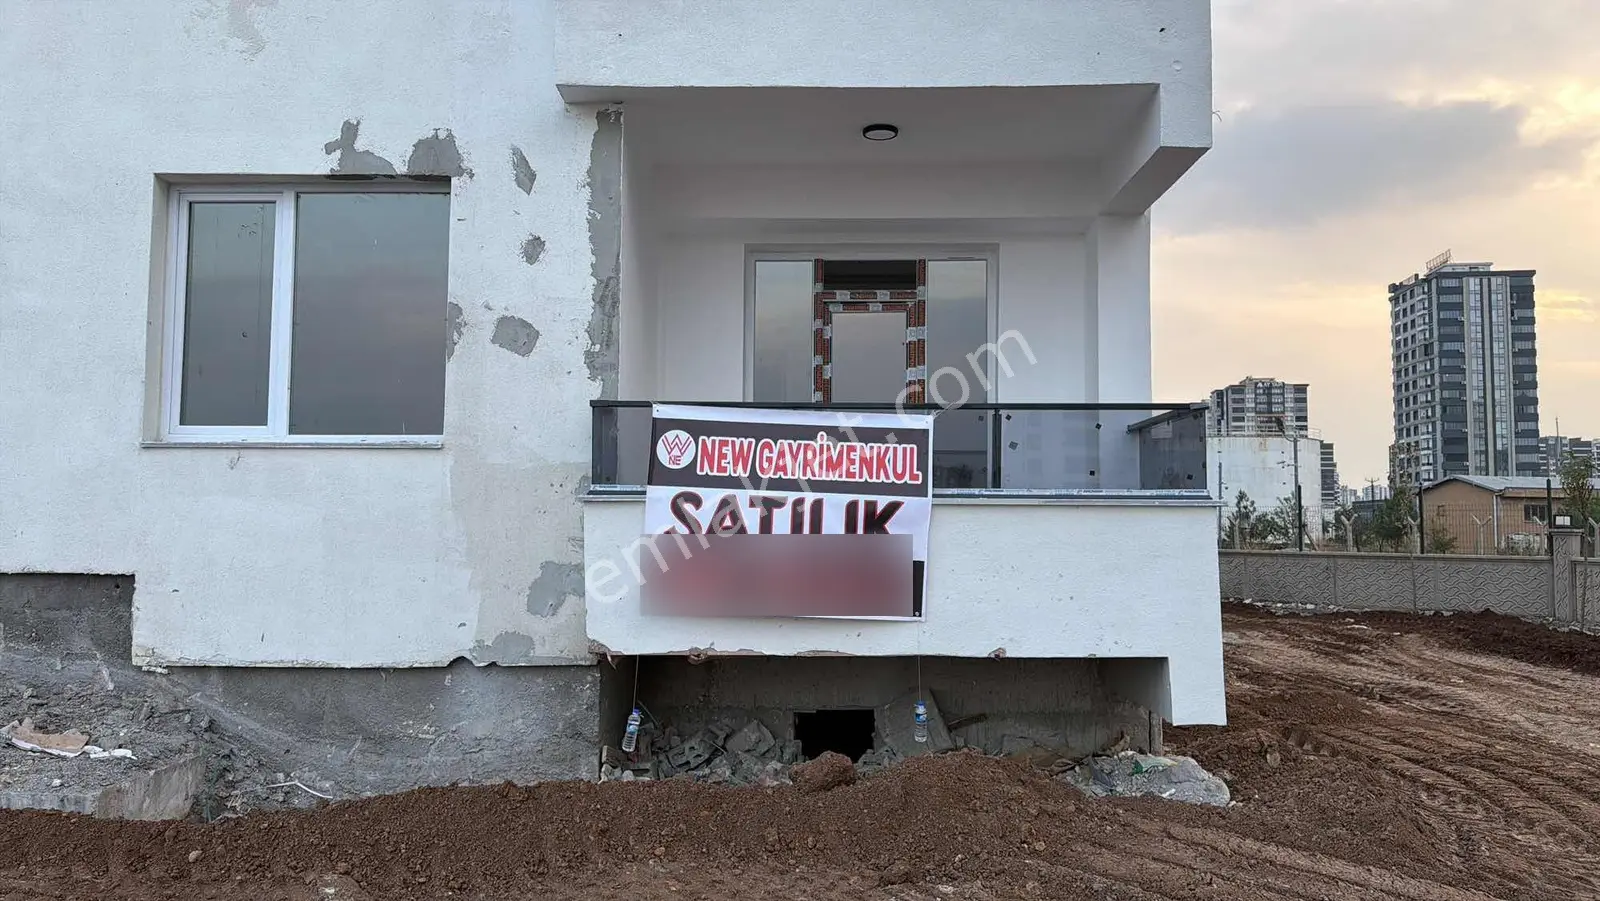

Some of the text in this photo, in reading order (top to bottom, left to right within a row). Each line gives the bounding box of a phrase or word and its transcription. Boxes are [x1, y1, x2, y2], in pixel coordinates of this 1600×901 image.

[668, 455, 682, 466] NE
[698, 432, 921, 483] NEW GAYRİMENKUL
